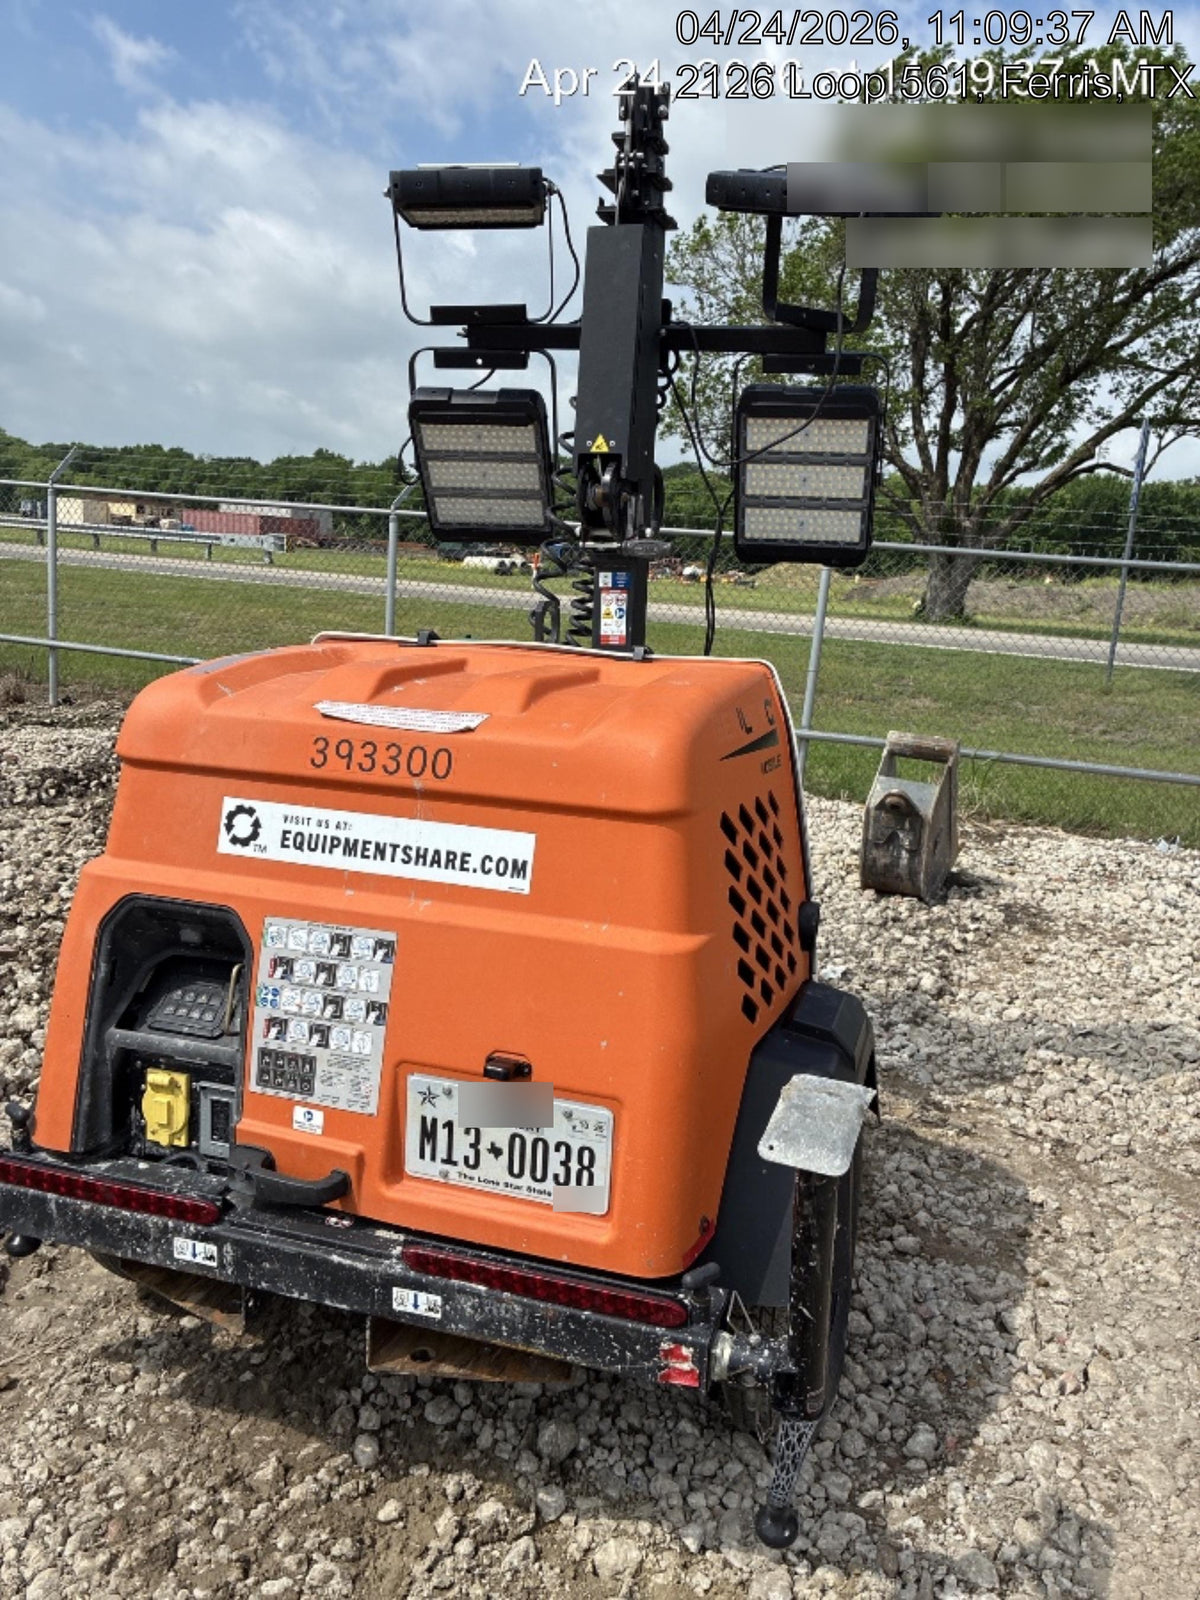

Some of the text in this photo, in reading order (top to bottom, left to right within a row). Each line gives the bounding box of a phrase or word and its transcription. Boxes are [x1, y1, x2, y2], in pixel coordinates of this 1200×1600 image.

[310, 736, 453, 779] 393300
[283, 814, 312, 827] VISIT
[280, 829, 528, 880] EQUIPMENTSHARE.COM
[418, 1114, 596, 1187] M13 0038
